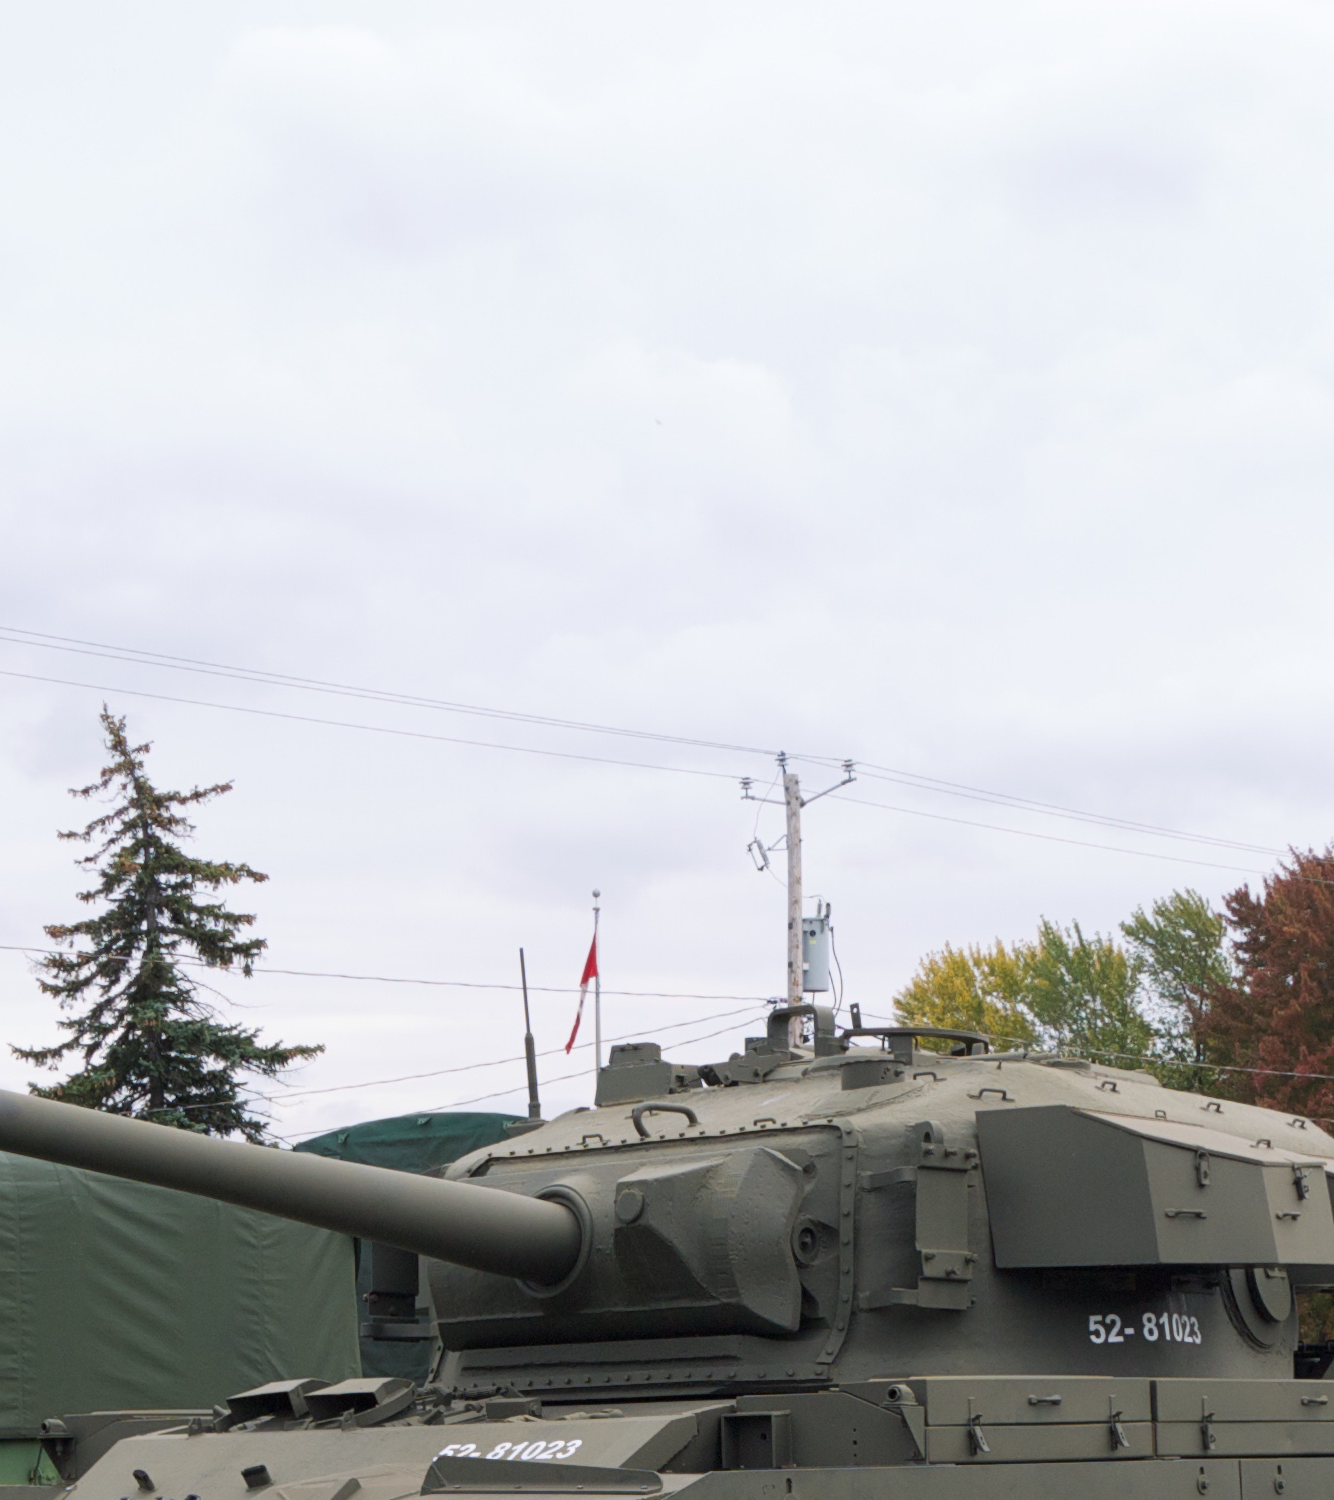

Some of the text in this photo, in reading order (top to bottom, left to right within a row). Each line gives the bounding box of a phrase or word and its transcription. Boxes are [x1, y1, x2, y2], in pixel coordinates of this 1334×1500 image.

[1089, 1312, 1202, 1345] 52- 81023
[485, 1439, 583, 1461] 81023
